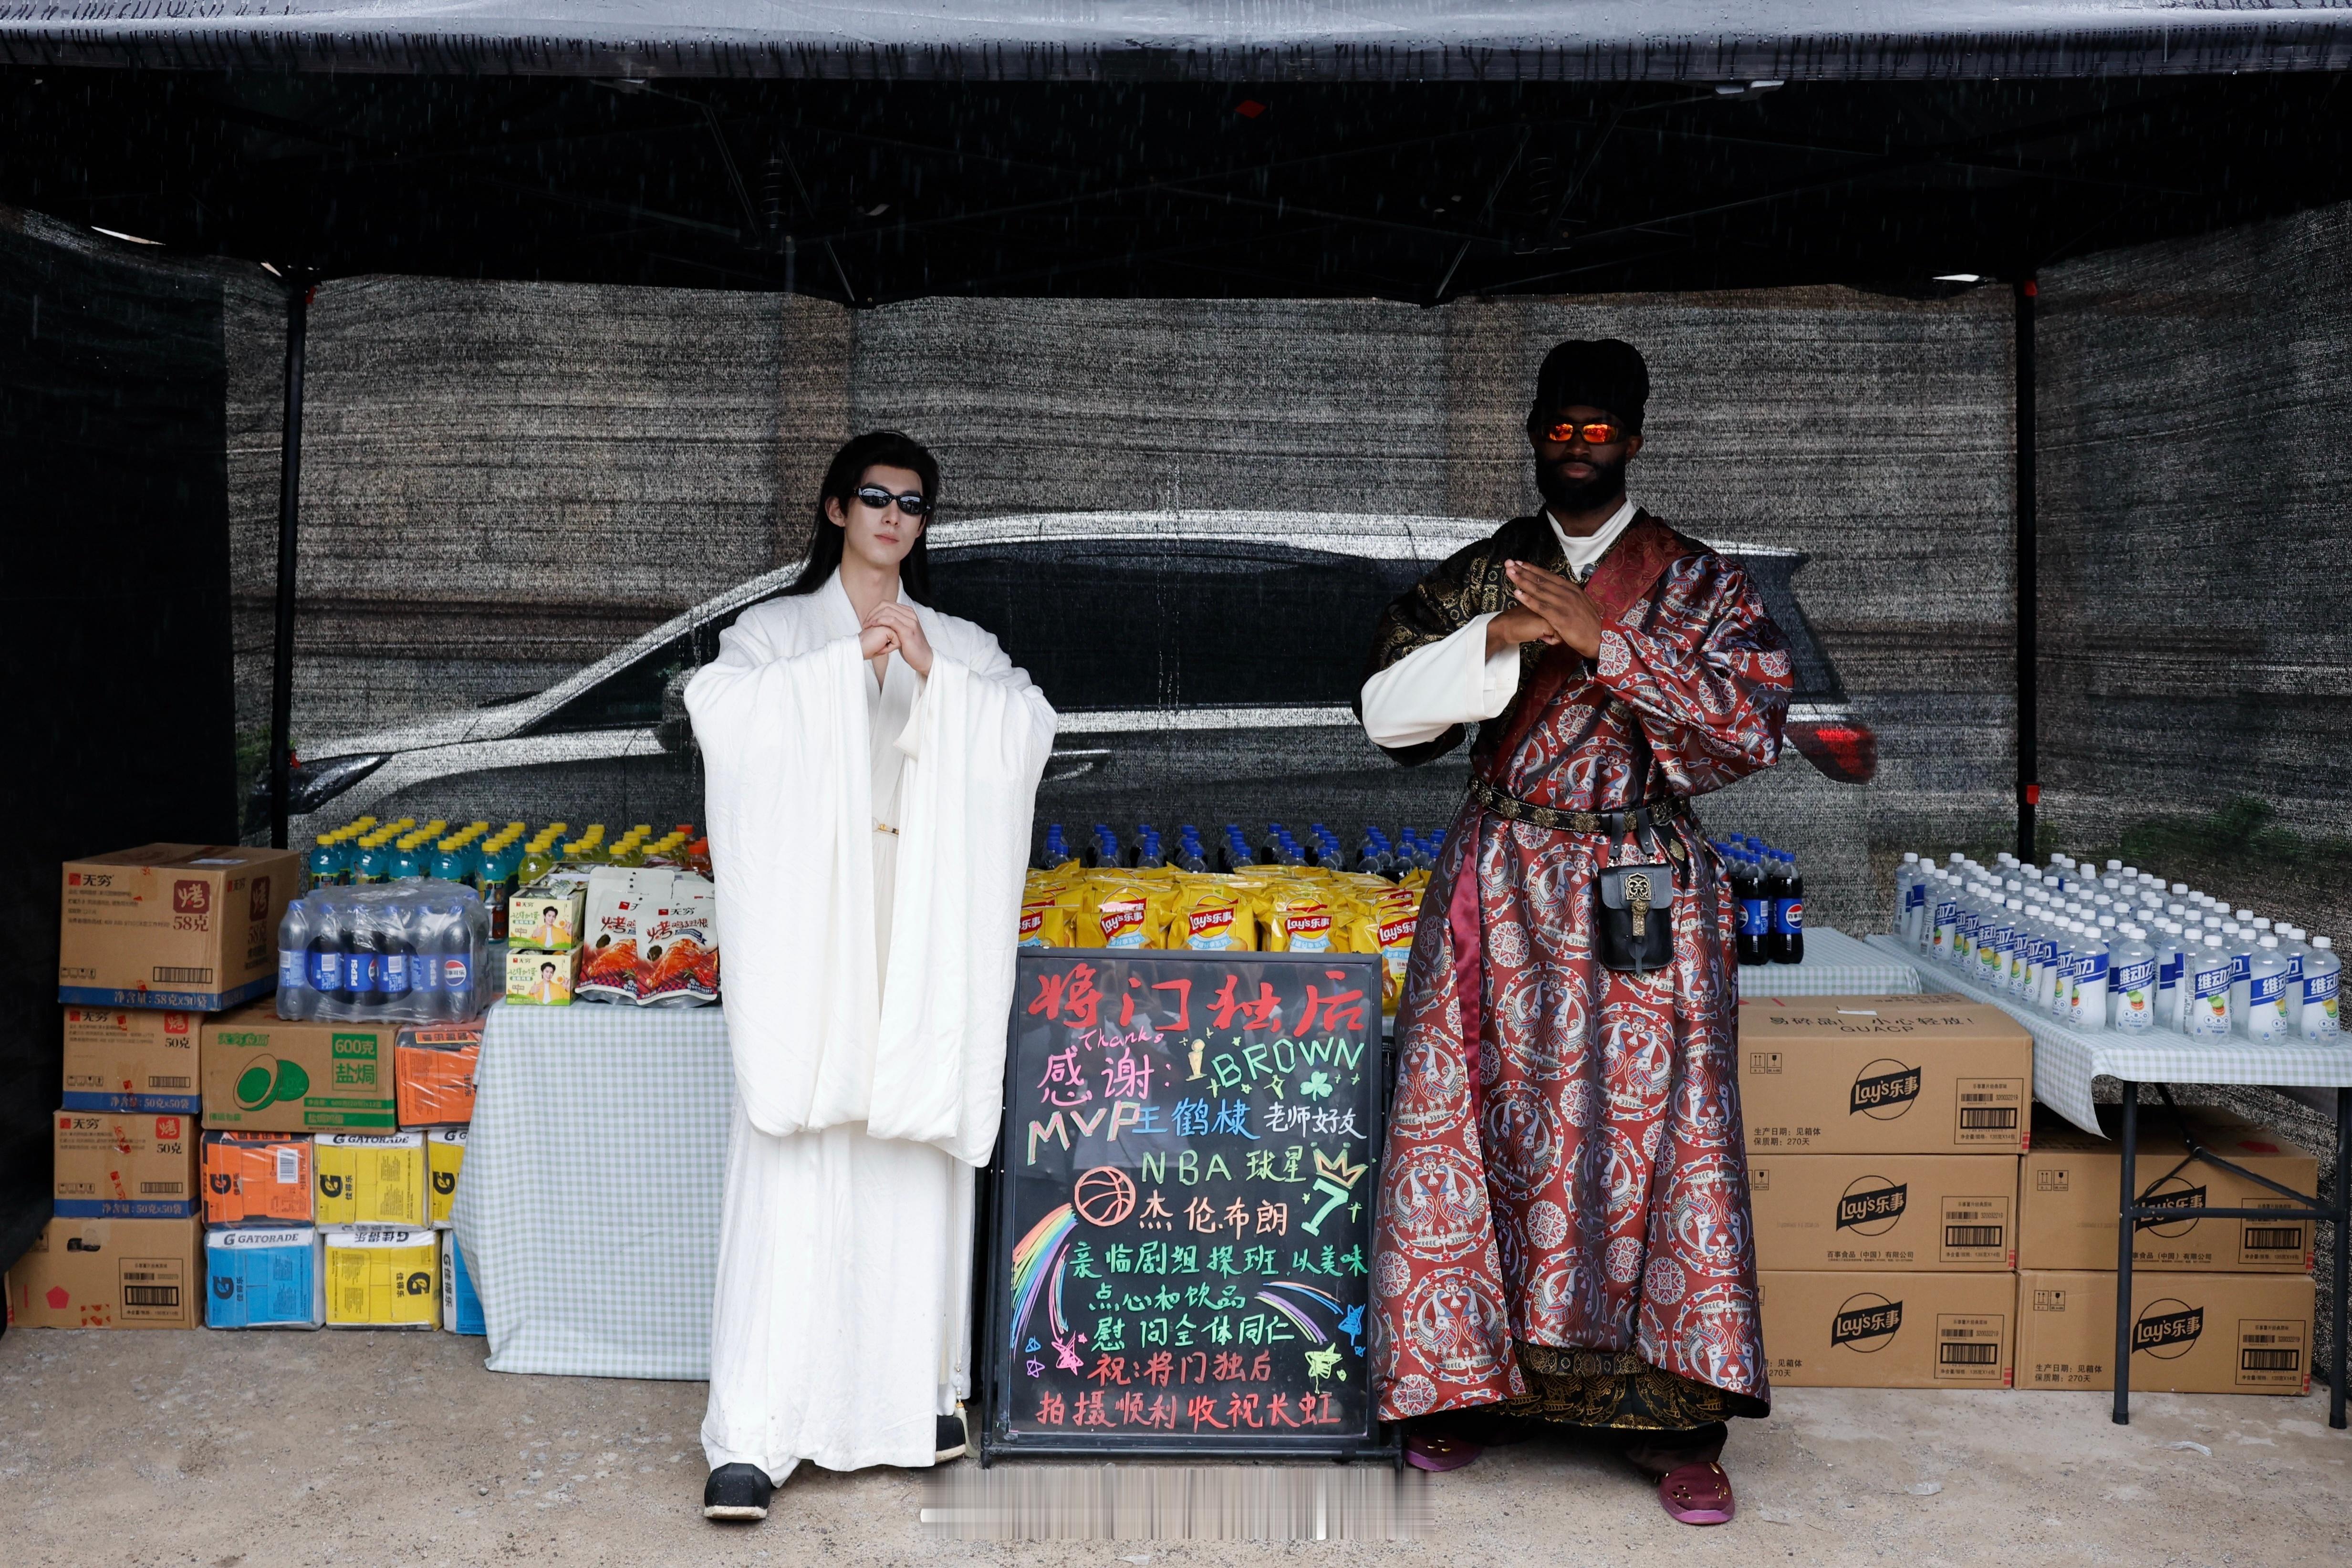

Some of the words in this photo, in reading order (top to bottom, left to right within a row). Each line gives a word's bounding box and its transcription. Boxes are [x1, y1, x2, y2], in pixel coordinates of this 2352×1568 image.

[83, 874, 113, 887] 无穷
[177, 883, 207, 908] 烤
[670, 907, 696, 916] 无穷
[173, 915, 209, 932] 58克
[1027, 963, 1366, 1038] 将门独后
[83, 1011, 108, 1022] 无穷
[165, 1037, 190, 1049] 50克
[335, 1039, 375, 1055] 600克
[1078, 1028, 1165, 1051] Thanks
[335, 1062, 375, 1085] 盐焗
[1211, 1037, 1364, 1089] BROWN
[1855, 1075, 1919, 1105] Lay's乐事
[73, 1118, 100, 1130] 无穷
[1027, 1100, 1141, 1166] MVP
[1132, 1096, 1262, 1141] 王鹤棣
[1264, 1103, 1367, 1140] 老师好友
[156, 1142, 182, 1154] 50克
[348, 1135, 410, 1144] GATORADE
[1754, 1137, 1810, 1146] 保质期:270天
[1141, 1149, 1233, 1186] NBA
[1245, 1145, 1308, 1184] 球星
[1301, 1178, 1350, 1236] 7
[1841, 1192, 1904, 1221] Lay's乐事
[238, 1233, 299, 1244] GATORADE
[1088, 1283, 1247, 1312] 点心和饮品
[1091, 1316, 1295, 1352] 慰问全体同仁
[1836, 1310, 1900, 1338] Lay's乐事
[2137, 1317, 2201, 1343] Lay's乐事
[2035, 1373, 2092, 1382] 保质期:270天
[1035, 1390, 1342, 1433] 拍摄顺利收视长虹
